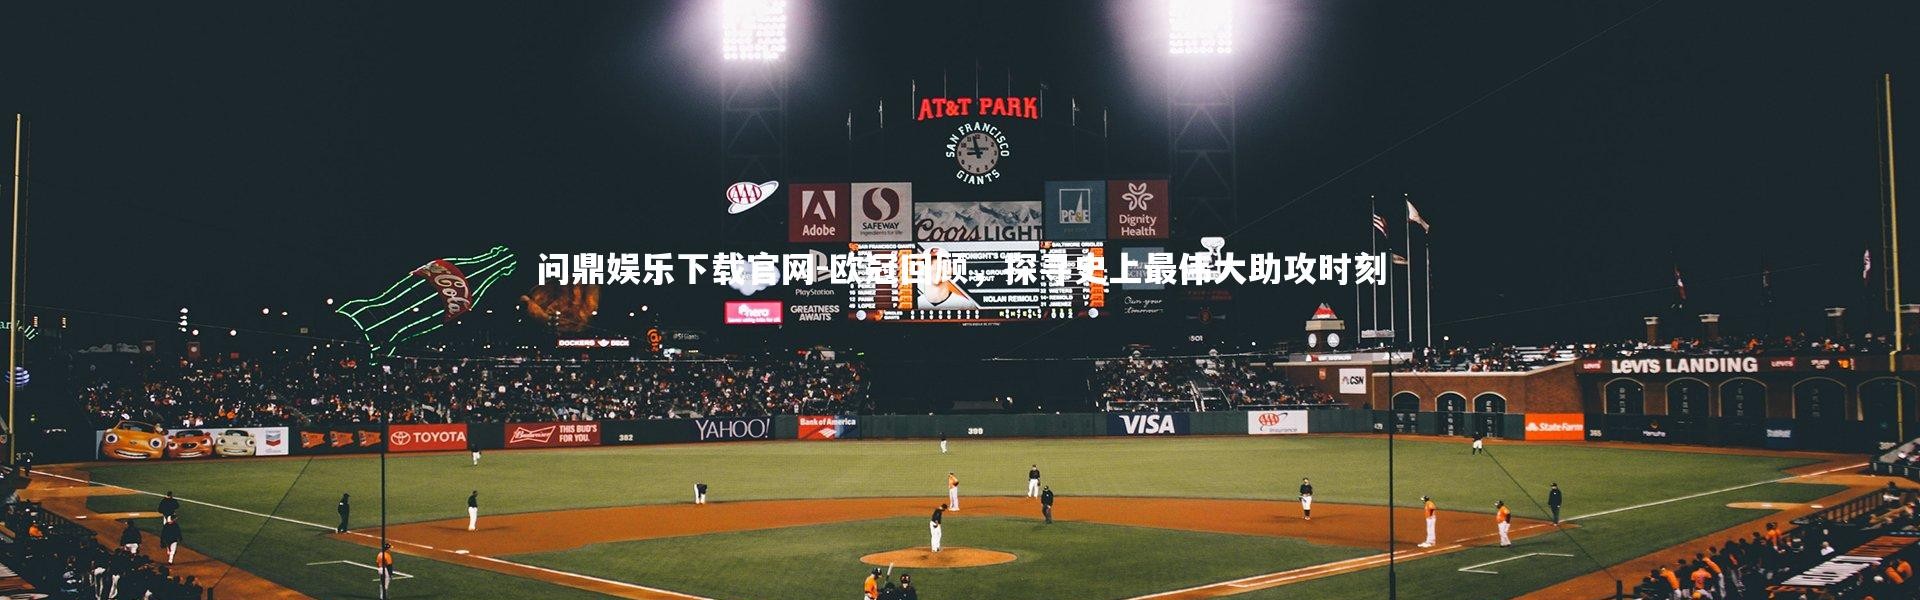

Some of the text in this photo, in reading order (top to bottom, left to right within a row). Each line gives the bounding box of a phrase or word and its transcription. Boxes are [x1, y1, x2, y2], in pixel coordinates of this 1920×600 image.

[918, 97, 1038, 120] AT&T PARK
[946, 122, 1010, 158] SAN FRANCISCO
[956, 169, 1000, 184] GIANTS
[732, 184, 762, 203] AAA
[1062, 210, 1090, 222] PG&E
[1119, 214, 1157, 226] Dignity
[802, 225, 836, 236] Adobe
[862, 222, 900, 230] SAFEWAY
[916, 218, 1042, 240] Coors LIGHT
[1121, 226, 1156, 236] Health
[796, 288, 834, 297] PlayStation
[790, 305, 840, 313] GREATNESS
[800, 313, 832, 321] AWAITS
[1666, 357, 1758, 374] LANDING
[1350, 376, 1364, 385] CSN
[826, 418, 856, 426] America
[1119, 415, 1176, 434] VISA
[559, 424, 597, 433] THIS BUD'S
[695, 418, 770, 440] YAHOO!
[413, 431, 466, 442] TOYOTA
[559, 434, 590, 442] FOR YOU.
